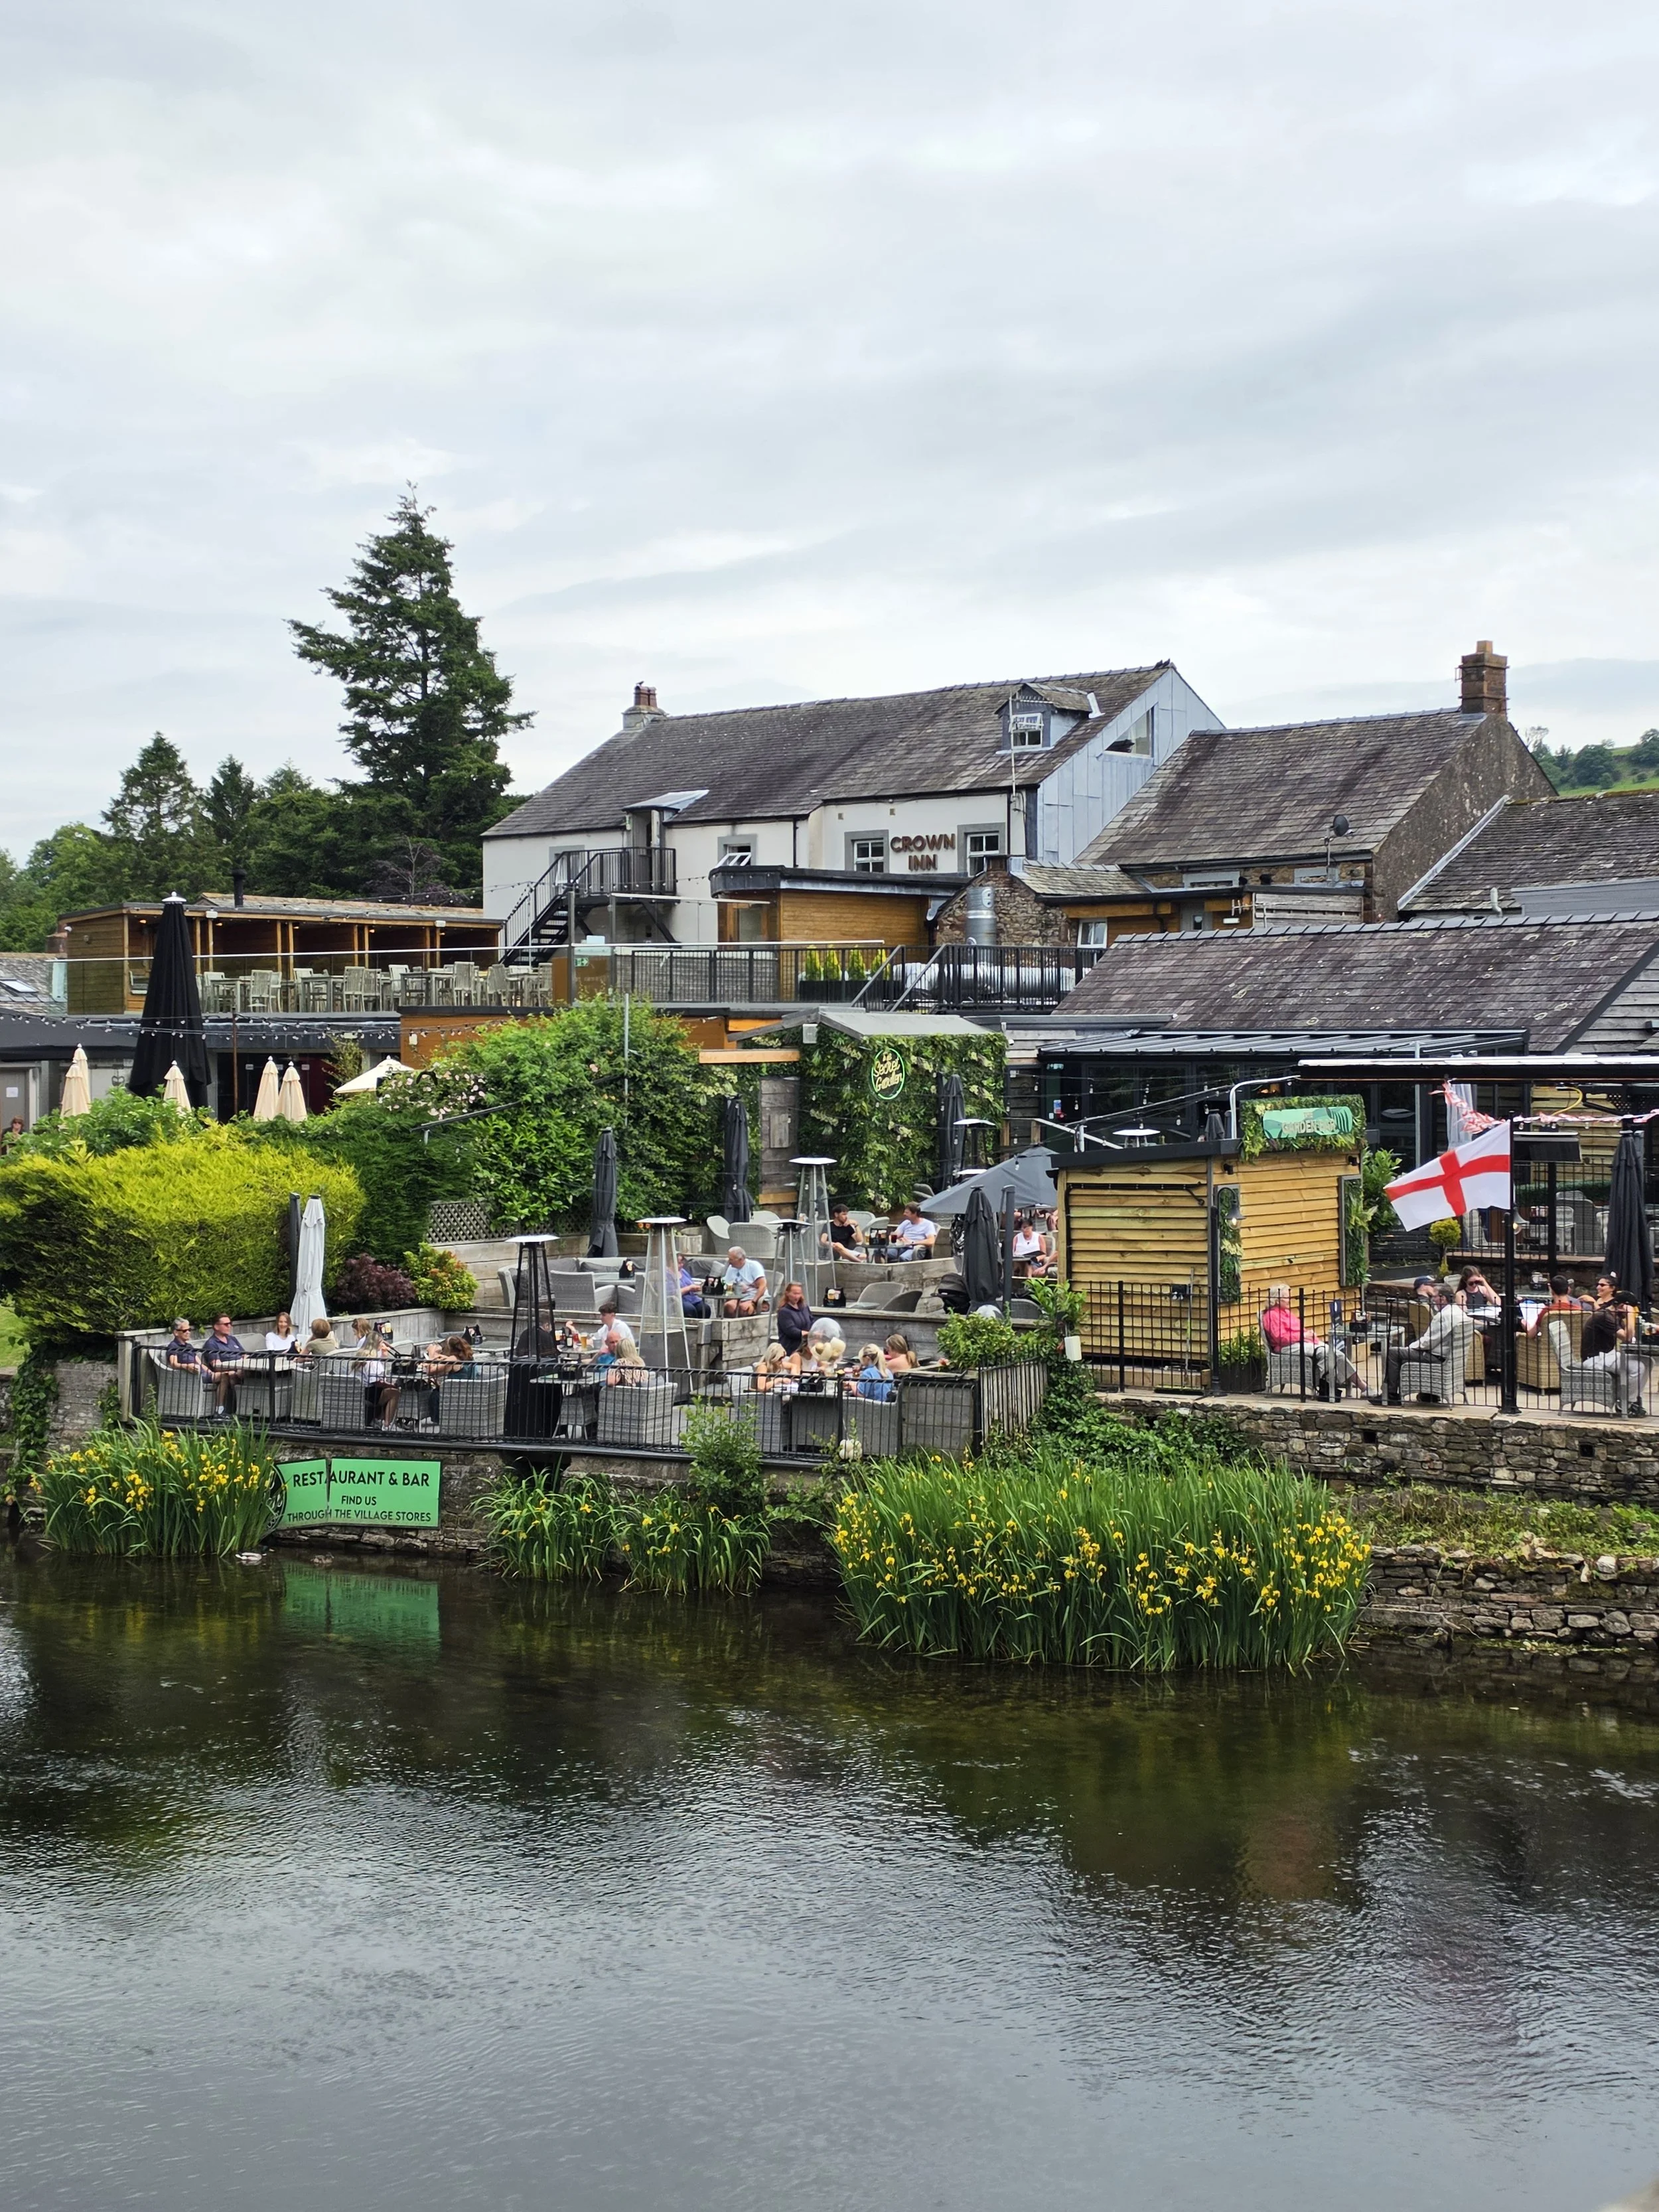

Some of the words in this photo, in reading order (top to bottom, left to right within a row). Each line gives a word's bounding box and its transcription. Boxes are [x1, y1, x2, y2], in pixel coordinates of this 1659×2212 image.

[891, 834, 956, 852] CROWN
[908, 854, 938, 871] INN
[293, 1470, 385, 1487] RESTAURANT
[388, 1472, 398, 1486] &
[402, 1472, 430, 1487] BAR
[341, 1495, 362, 1505] FIND
[364, 1496, 377, 1506] US
[287, 1509, 331, 1522] THROUGH
[334, 1509, 351, 1518] THE
[354, 1509, 393, 1520] VILLAGE
[396, 1511, 431, 1522] STORES
